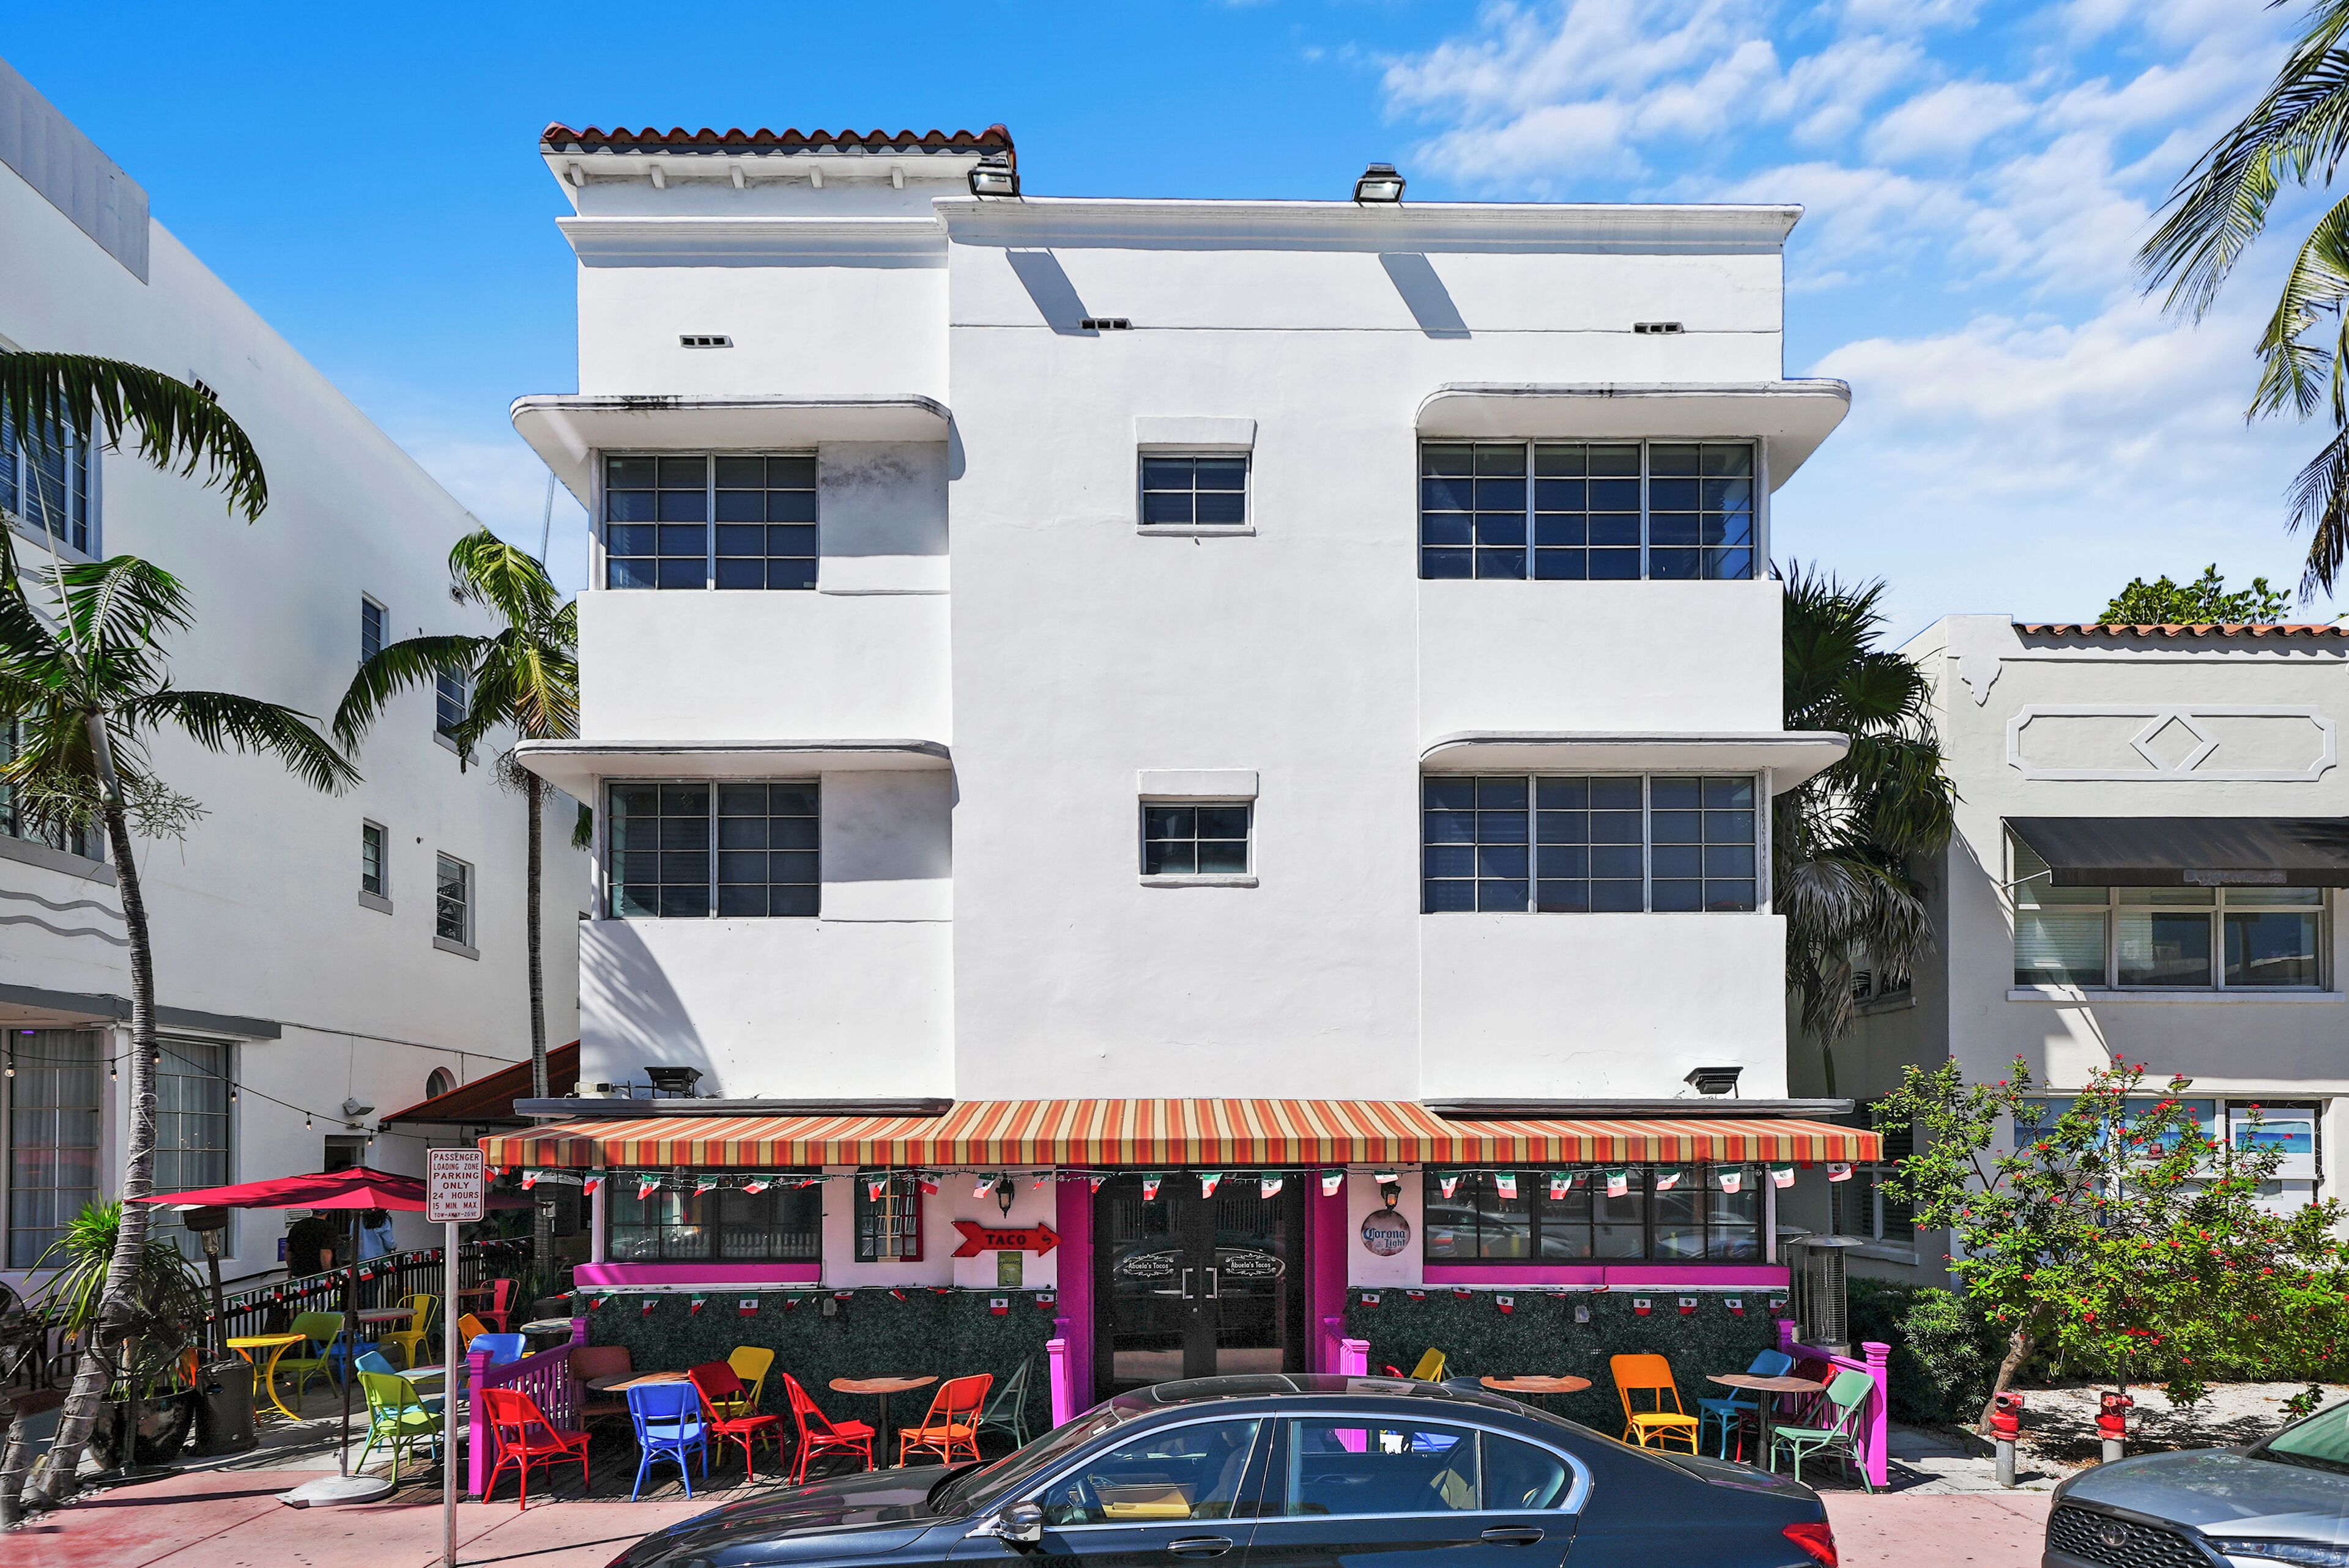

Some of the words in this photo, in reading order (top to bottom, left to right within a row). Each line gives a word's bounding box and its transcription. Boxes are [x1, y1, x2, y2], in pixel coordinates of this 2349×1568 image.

[985, 1234, 1026, 1245] TACO
[1363, 1227, 1405, 1241] Corona
[1384, 1238, 1405, 1249] Light
